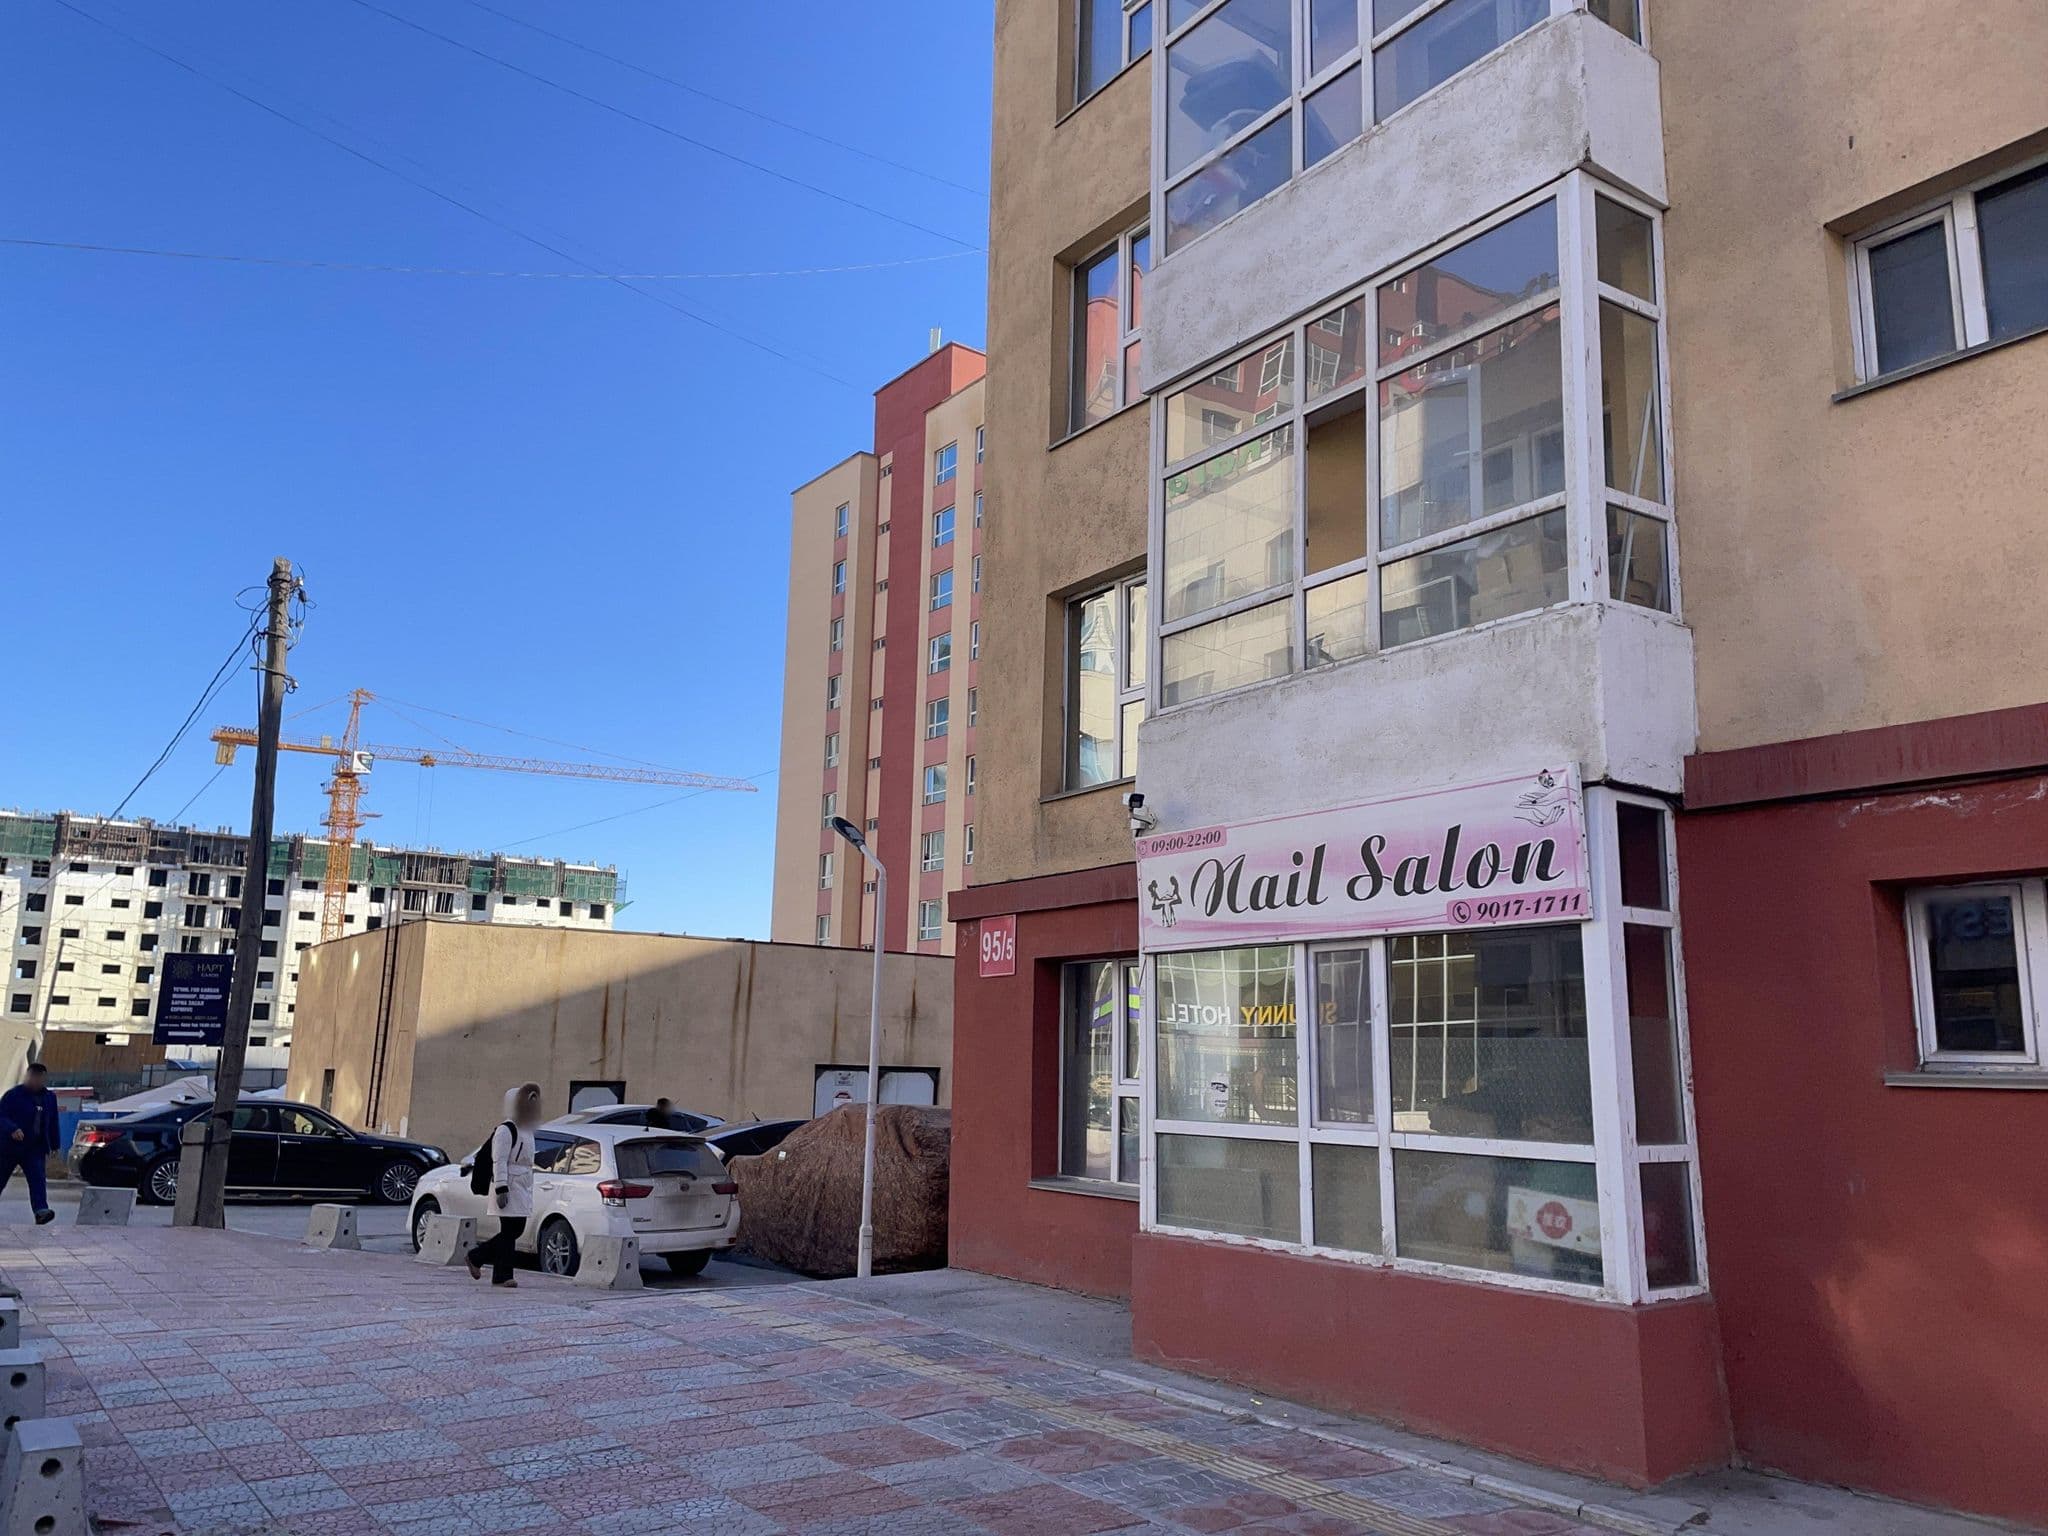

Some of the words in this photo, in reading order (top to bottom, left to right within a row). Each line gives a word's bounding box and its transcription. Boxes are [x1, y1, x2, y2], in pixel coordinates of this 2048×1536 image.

[1151, 830, 1222, 854] 09:00-22:00
[1190, 843, 1329, 917] Nail
[1346, 823, 1565, 902] Salon
[1476, 894, 1582, 922] 9017-1711
[982, 930, 1013, 963] 95/5
